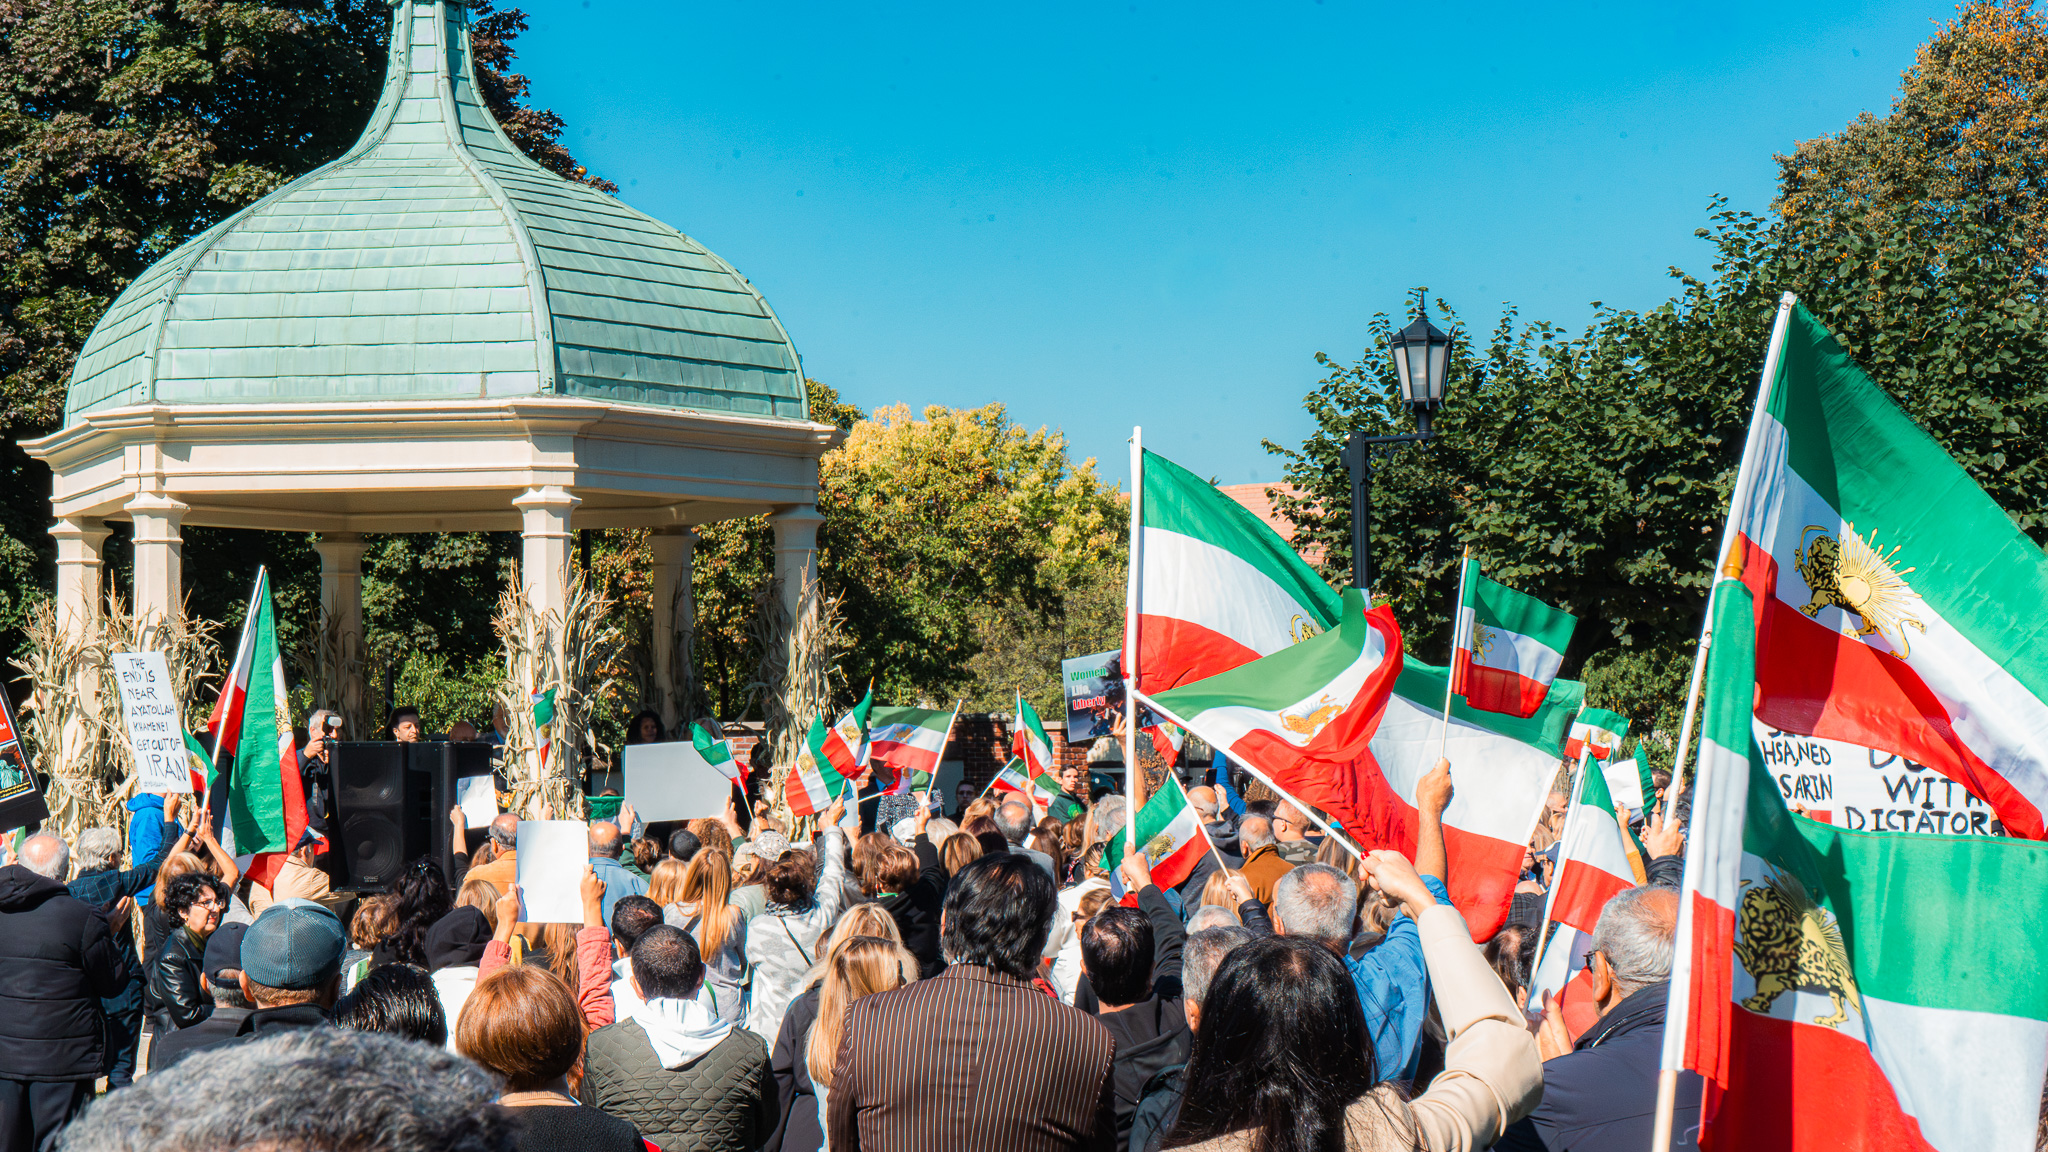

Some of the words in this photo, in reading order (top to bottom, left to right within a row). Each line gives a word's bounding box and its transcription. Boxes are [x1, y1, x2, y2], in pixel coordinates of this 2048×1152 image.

[129, 658, 145, 670] THE
[123, 671, 142, 683] END
[145, 670, 156, 683] IS
[1070, 667, 1109, 682] Women,
[128, 687, 158, 700] NEAR
[1072, 684, 1092, 697] Life,
[1073, 695, 1106, 710] Liberty
[132, 704, 174, 717] AYATOLLAH
[133, 721, 169, 732] KHAMENEI
[136, 738, 150, 751] GET
[151, 737, 169, 751] OUT
[170, 738, 181, 751] OF
[146, 754, 187, 782] IRAN
[1845, 805, 1990, 836] DICTATOR
